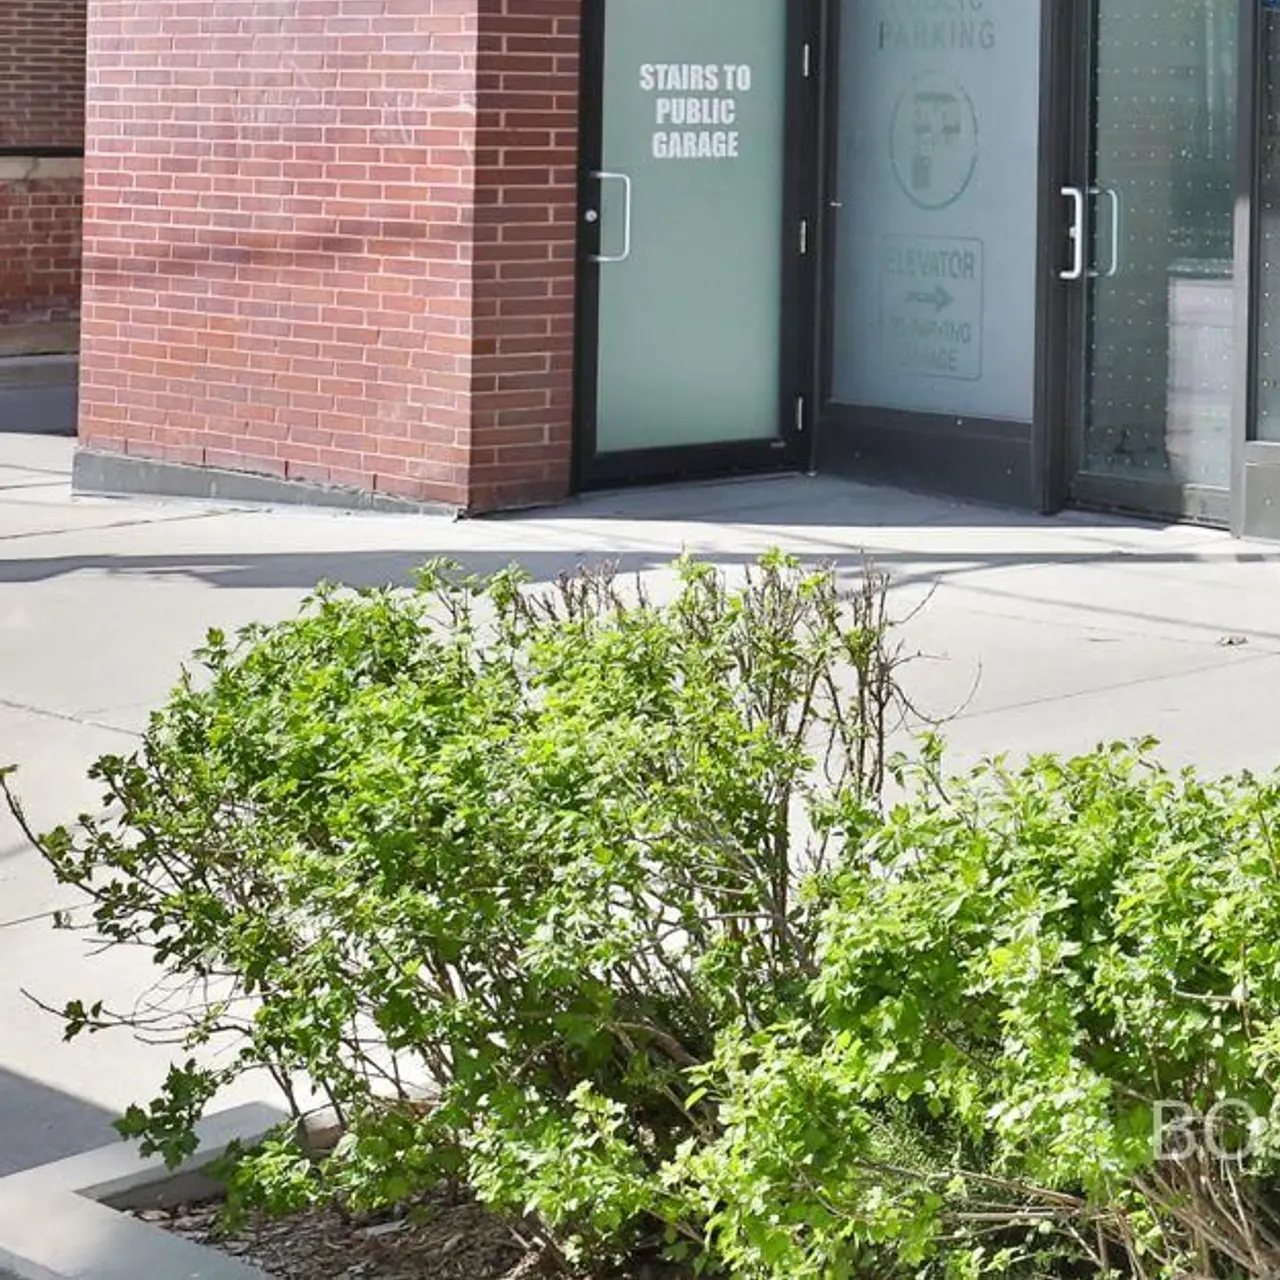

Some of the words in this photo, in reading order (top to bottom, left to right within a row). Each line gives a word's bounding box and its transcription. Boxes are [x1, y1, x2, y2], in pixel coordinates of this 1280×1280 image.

[878, 18, 996, 49] PARKING
[639, 63, 719, 91] STAIRS
[723, 64, 751, 91] TO
[655, 97, 736, 124] PUBLIC
[652, 131, 739, 159] GARAGE
[887, 246, 975, 280] ELEVATOR
